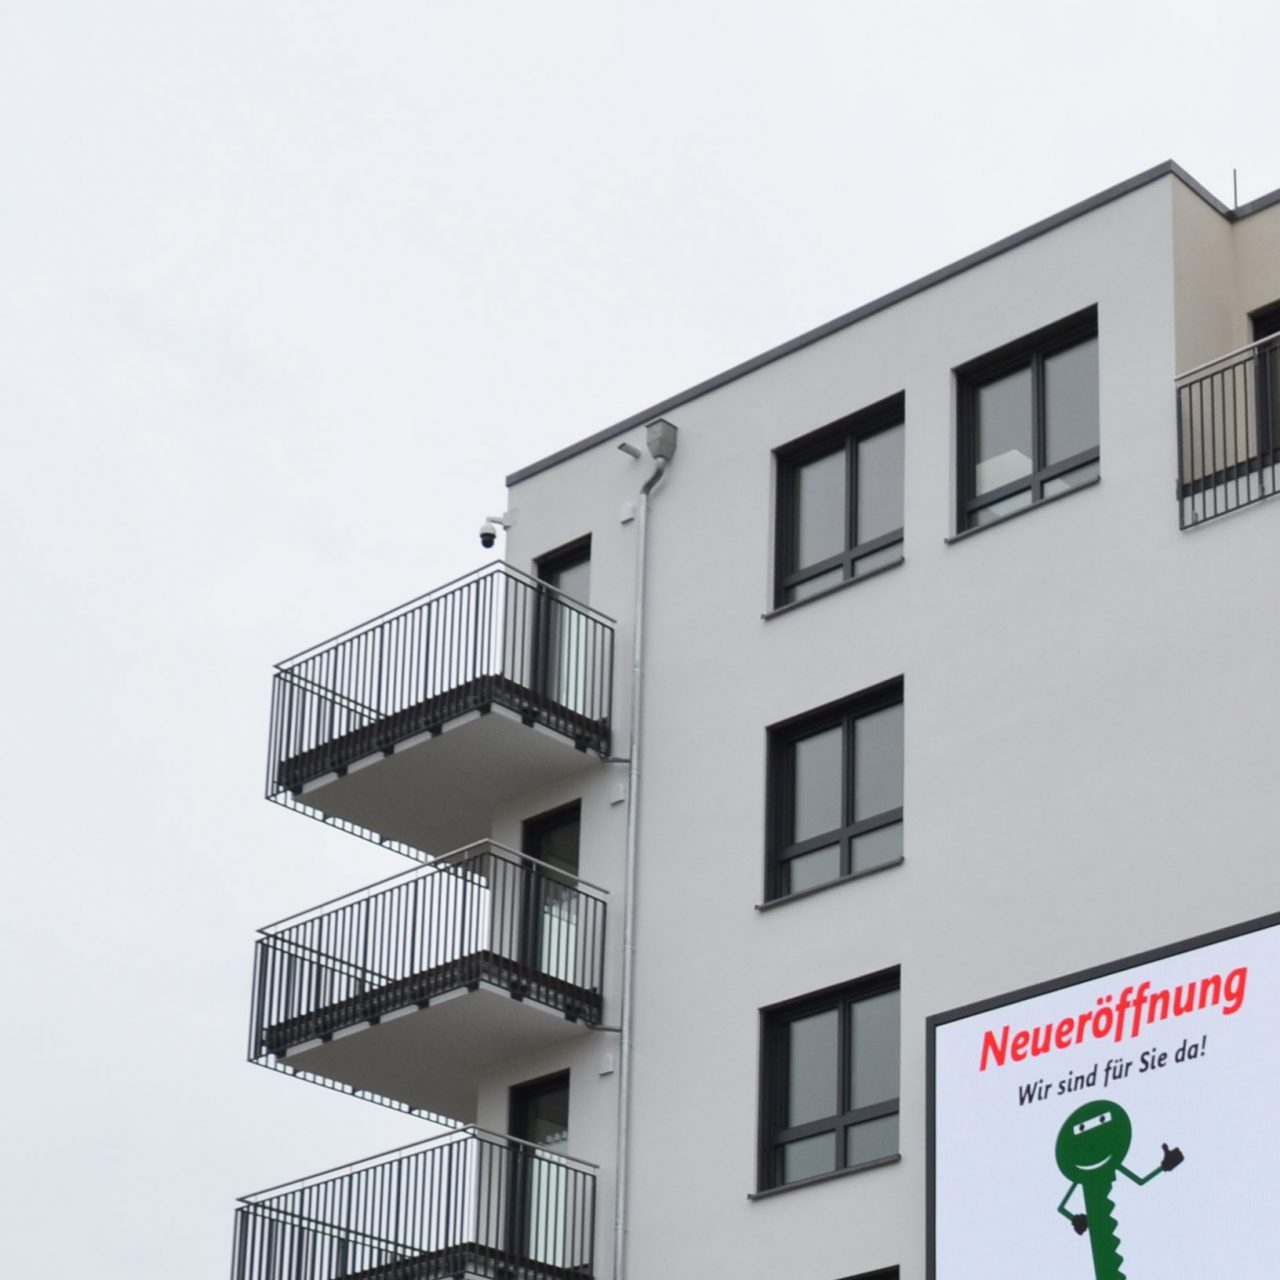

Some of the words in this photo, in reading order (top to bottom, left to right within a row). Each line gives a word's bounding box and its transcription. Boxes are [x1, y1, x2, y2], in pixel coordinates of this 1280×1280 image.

[979, 966, 1248, 1072] Neueröffnung
[1018, 1079, 1052, 1106] Wir
[1057, 1063, 1098, 1095] sind
[1103, 1058, 1133, 1087] für
[1139, 1047, 1168, 1073] Sie
[1174, 1035, 1208, 1063] da!
